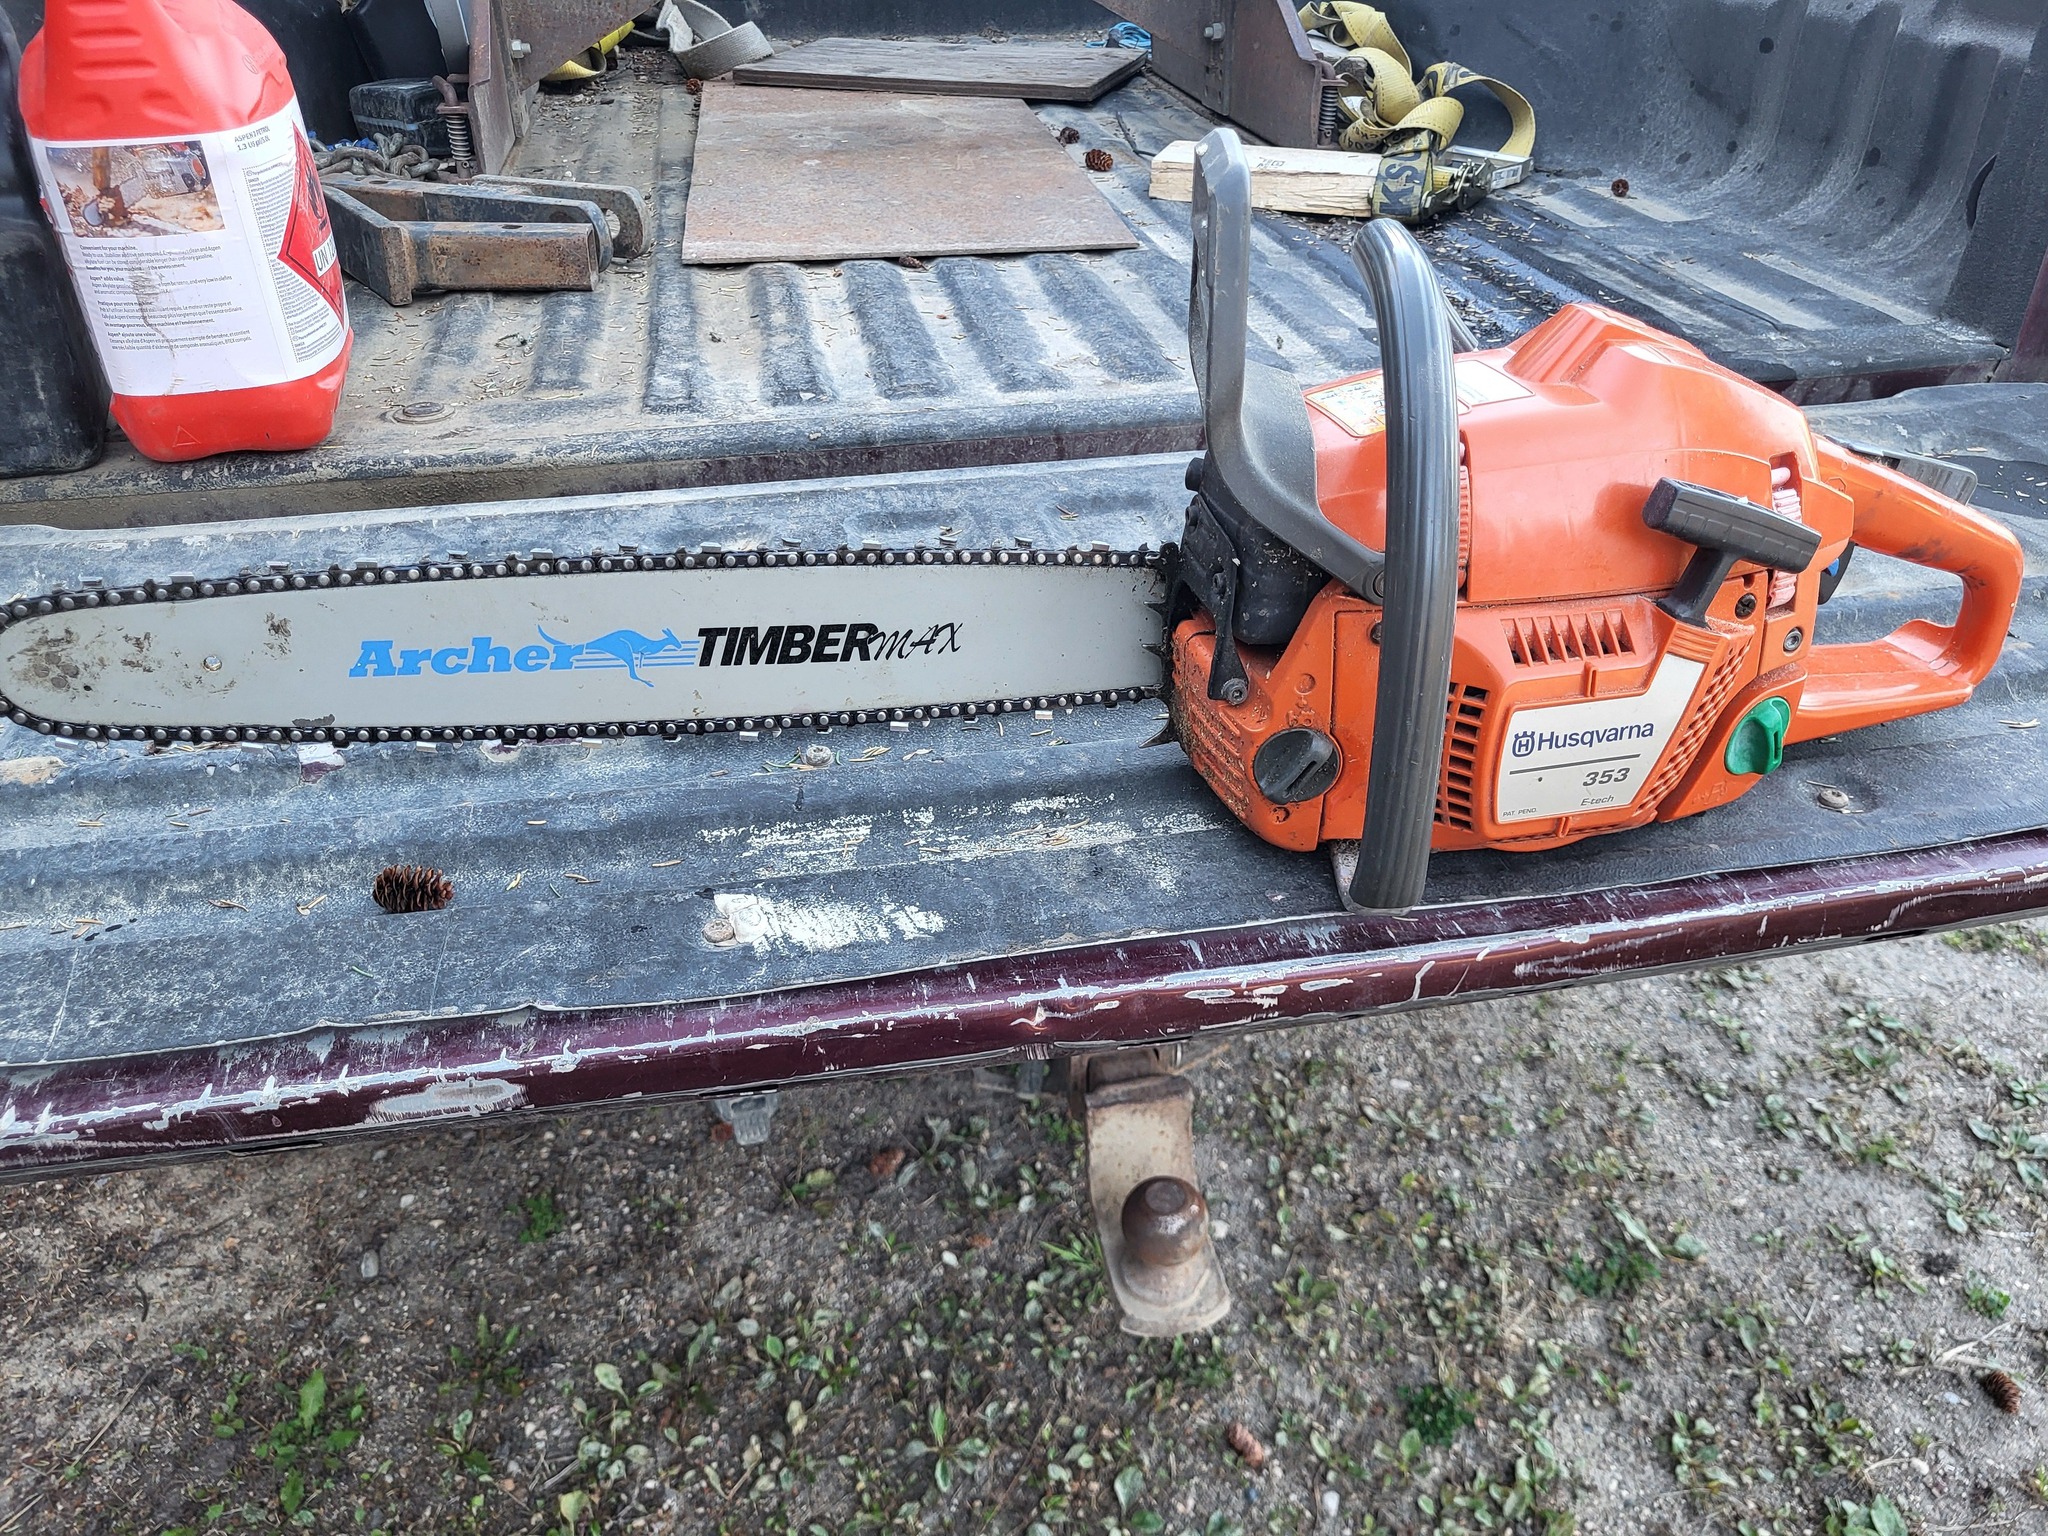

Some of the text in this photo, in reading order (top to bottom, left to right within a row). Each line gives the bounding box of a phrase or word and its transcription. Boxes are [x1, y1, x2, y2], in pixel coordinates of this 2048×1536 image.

[234, 130, 254, 142] ASPEN
[349, 636, 586, 678] Archer
[1537, 722, 1654, 751] Husqvarna
[1582, 767, 1631, 787] 353
[1580, 795, 1615, 806] E-tech
